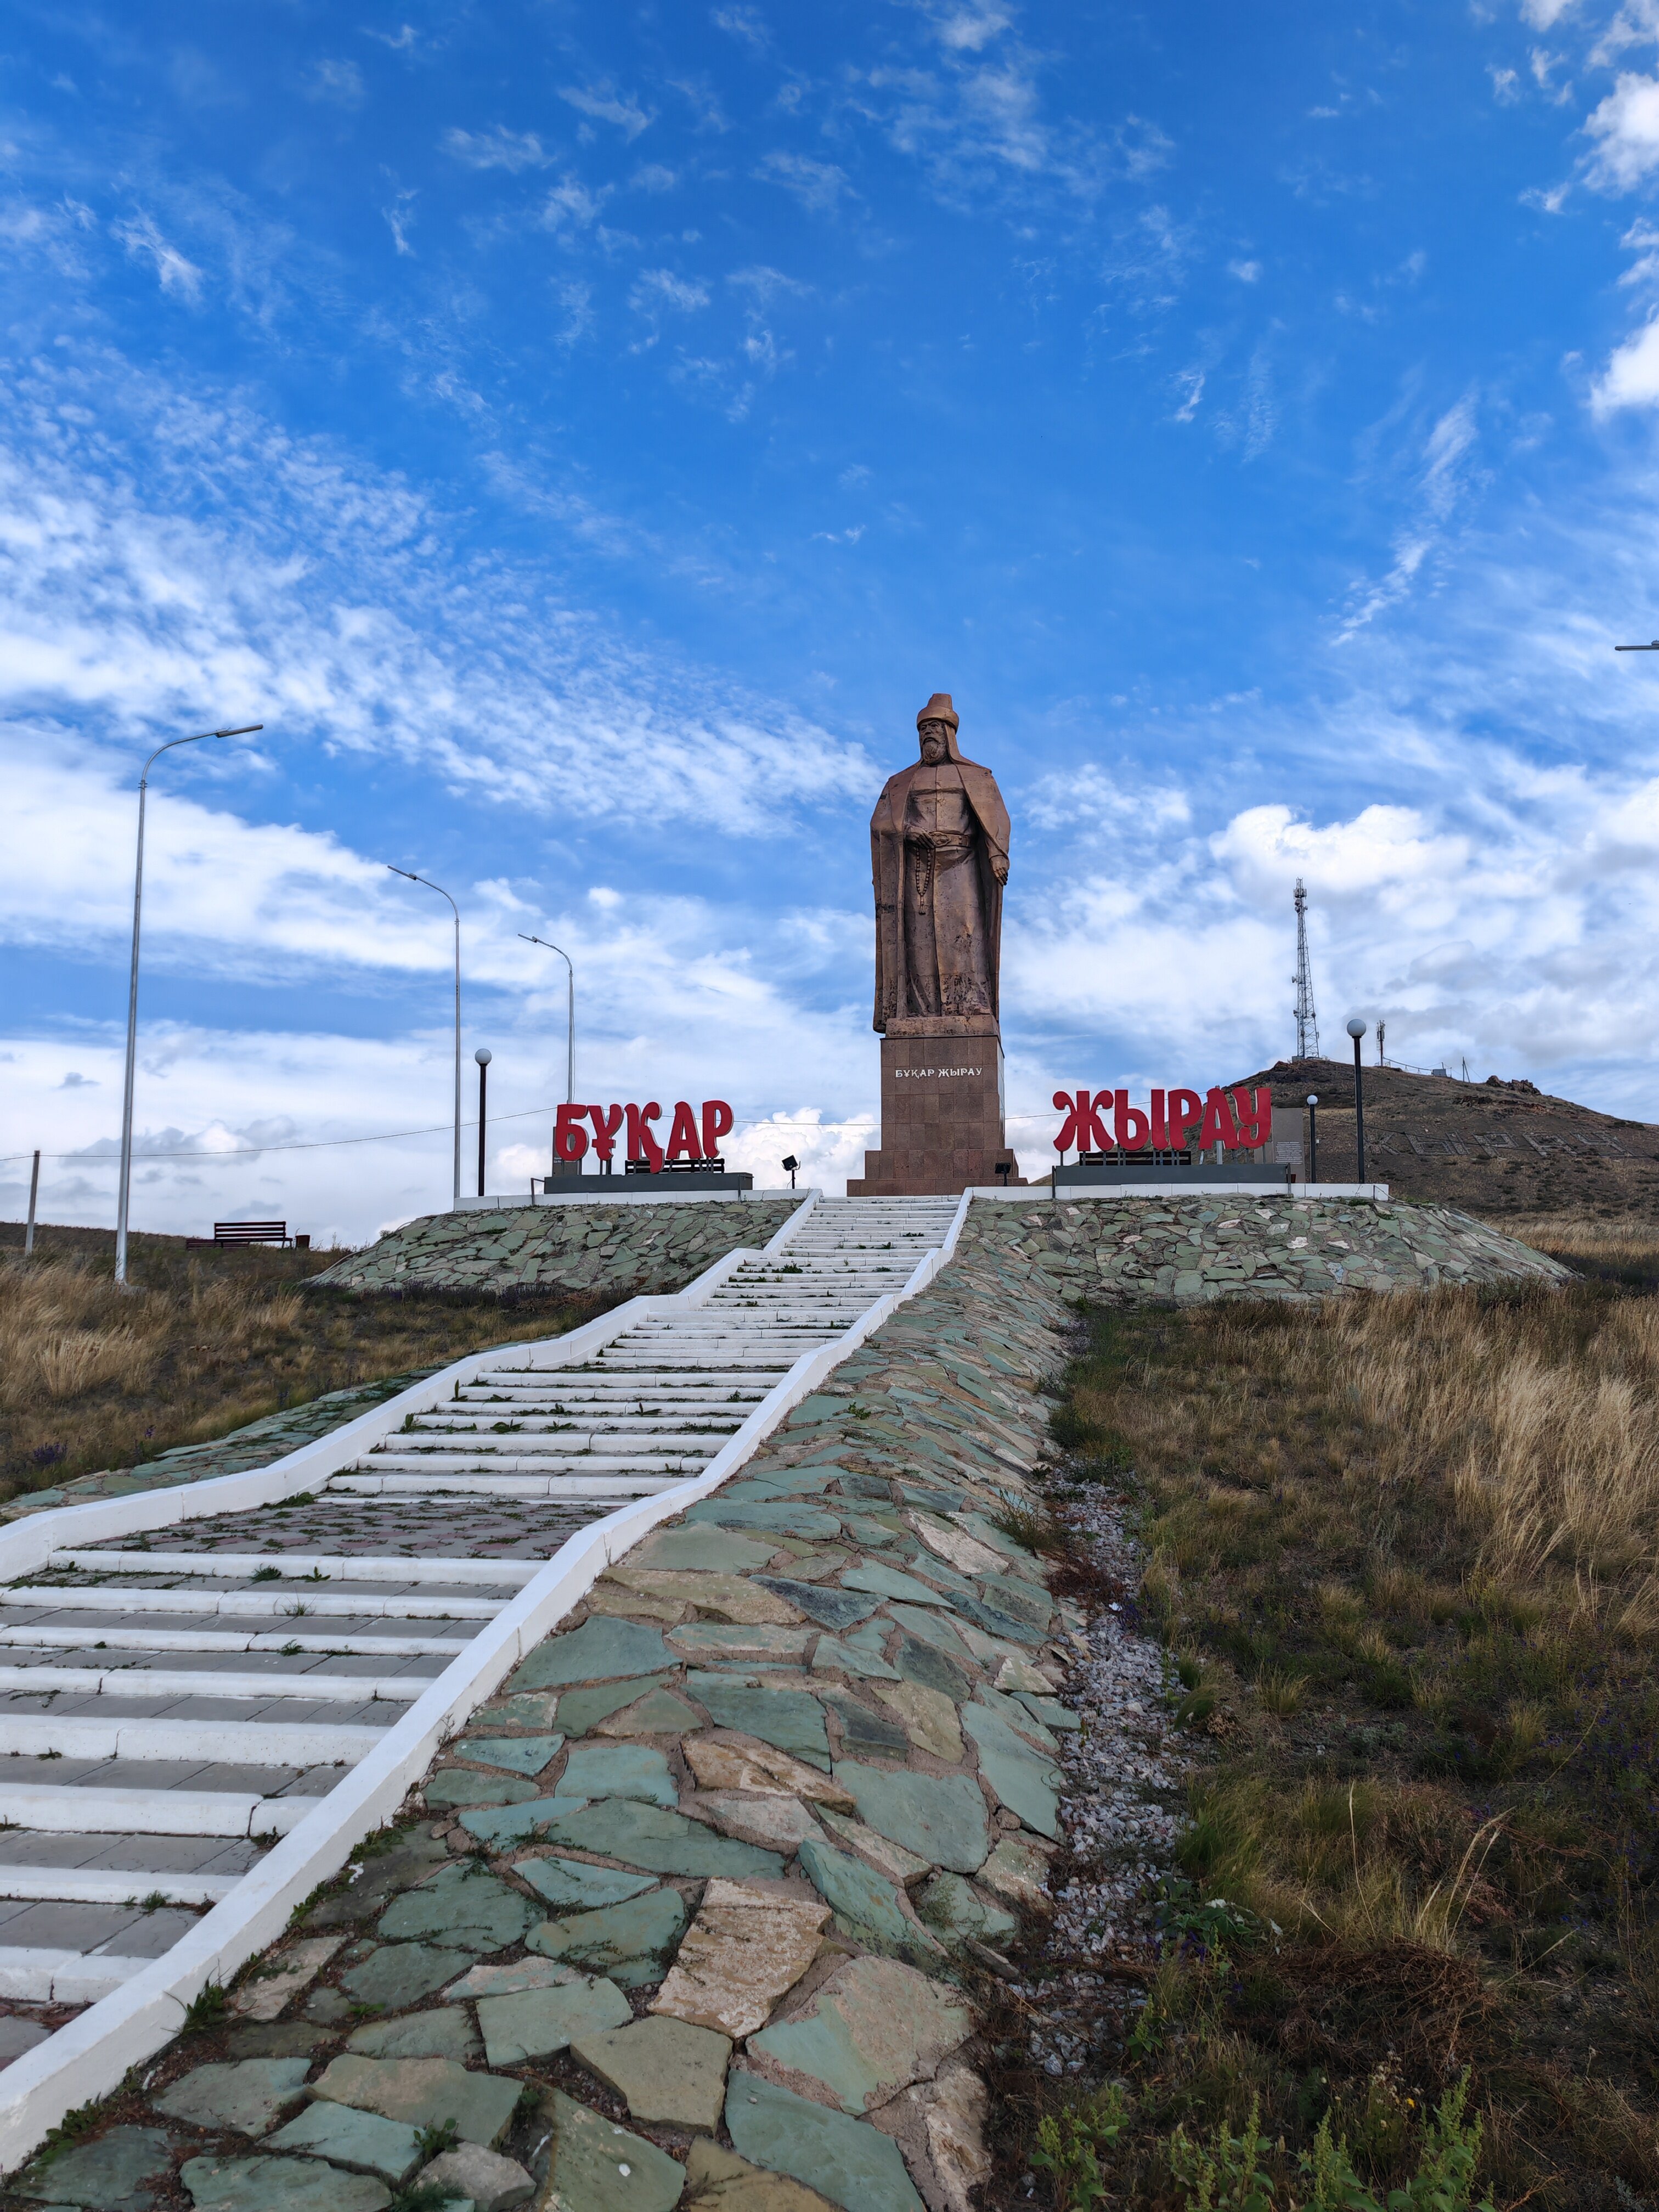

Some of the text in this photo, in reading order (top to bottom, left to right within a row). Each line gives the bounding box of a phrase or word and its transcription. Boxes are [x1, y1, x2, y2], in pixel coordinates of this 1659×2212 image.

[895, 1068, 982, 1079] БҰҚАР ЖЫРАУ
[556, 1087, 1271, 1173] БҰҚАР ЖЫРАУ
